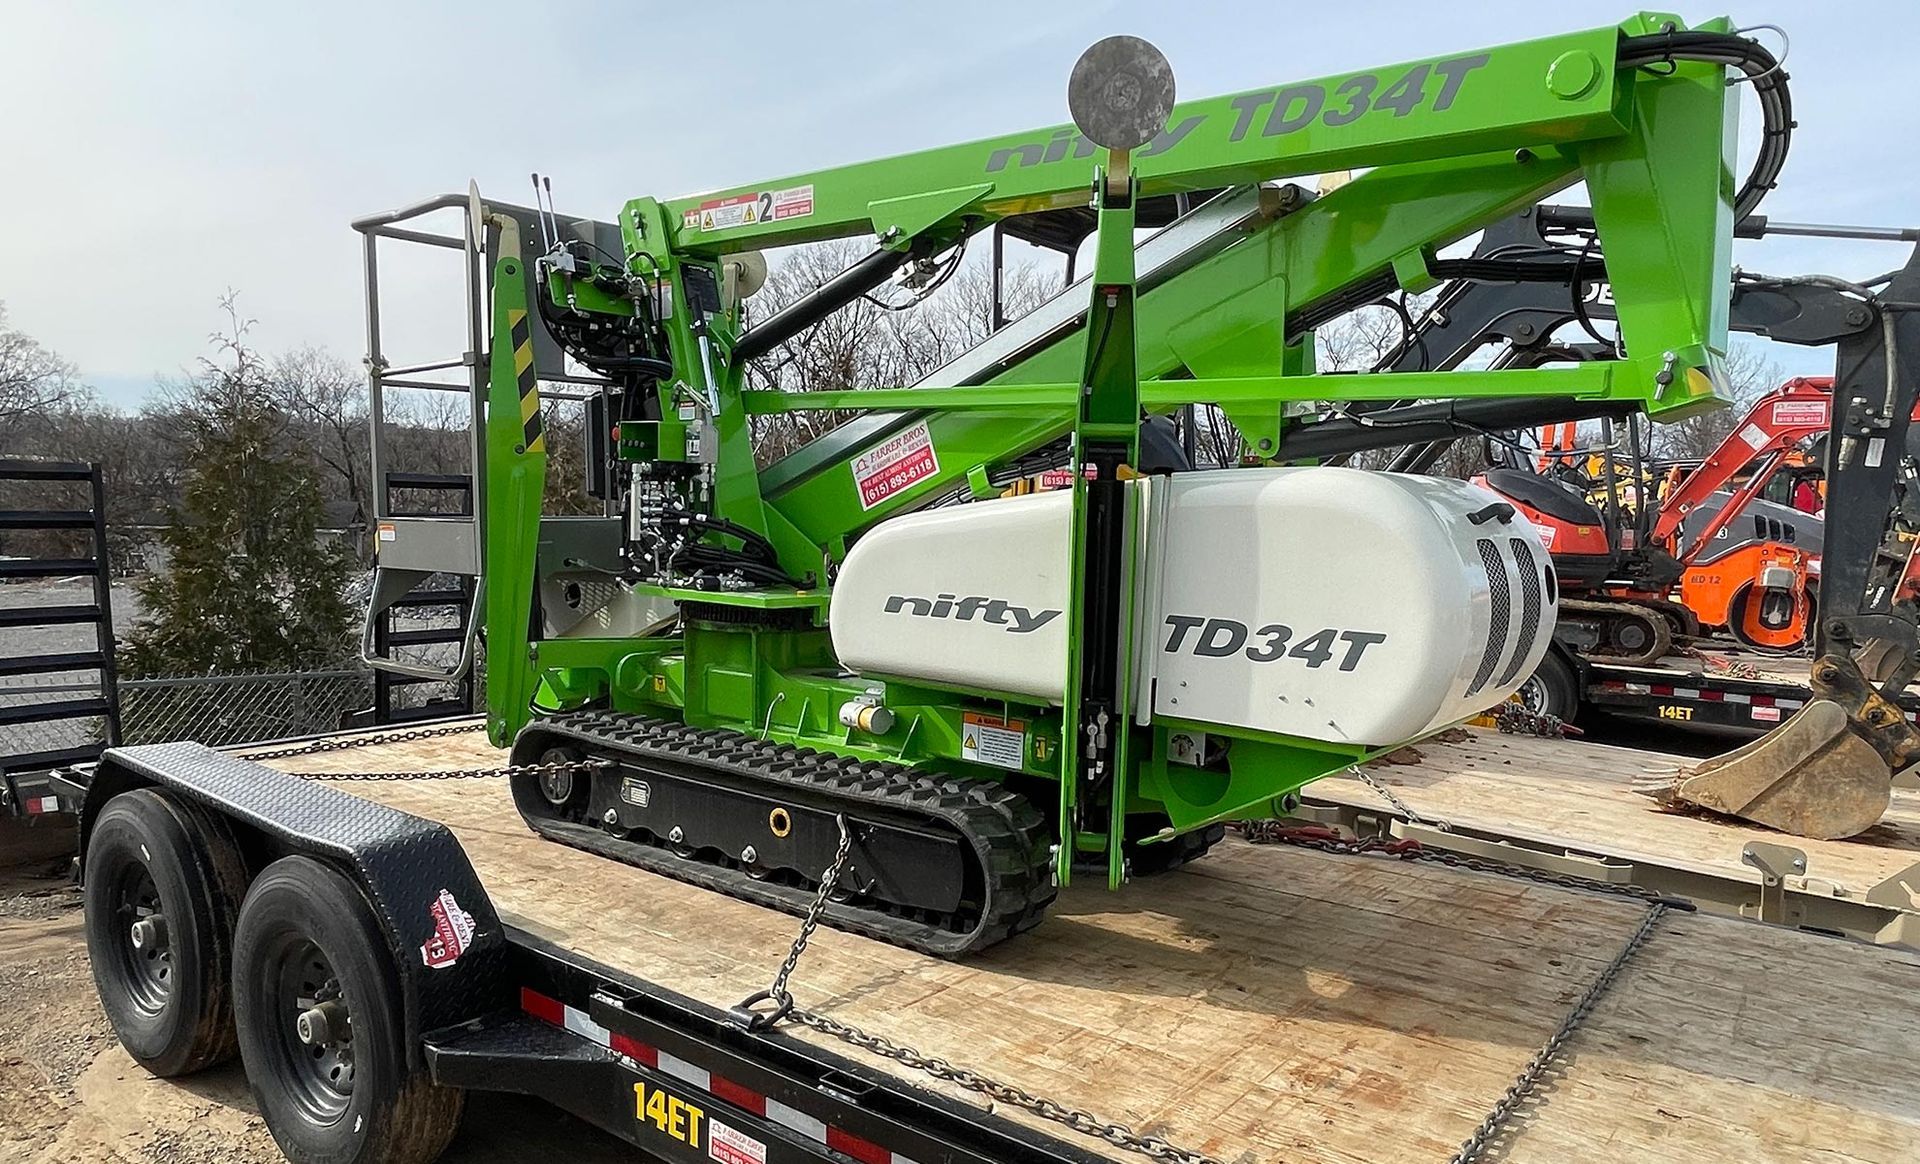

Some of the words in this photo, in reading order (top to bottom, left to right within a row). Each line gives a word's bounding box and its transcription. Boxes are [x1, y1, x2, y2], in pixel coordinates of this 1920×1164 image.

[986, 129, 1209, 172] niy
[1229, 53, 1491, 142] TD34T
[759, 192, 773, 223] 2
[870, 440, 902, 463] FARRER
[902, 424, 926, 445] BROS
[866, 481, 889, 503] (615)
[890, 458, 933, 489] 893-6118
[1043, 475, 1064, 486] (615)
[884, 594, 1063, 632] nifty
[1165, 615, 1387, 672] TD34T
[1658, 705, 1694, 721] 14ET
[633, 1081, 705, 1149] 14ET
